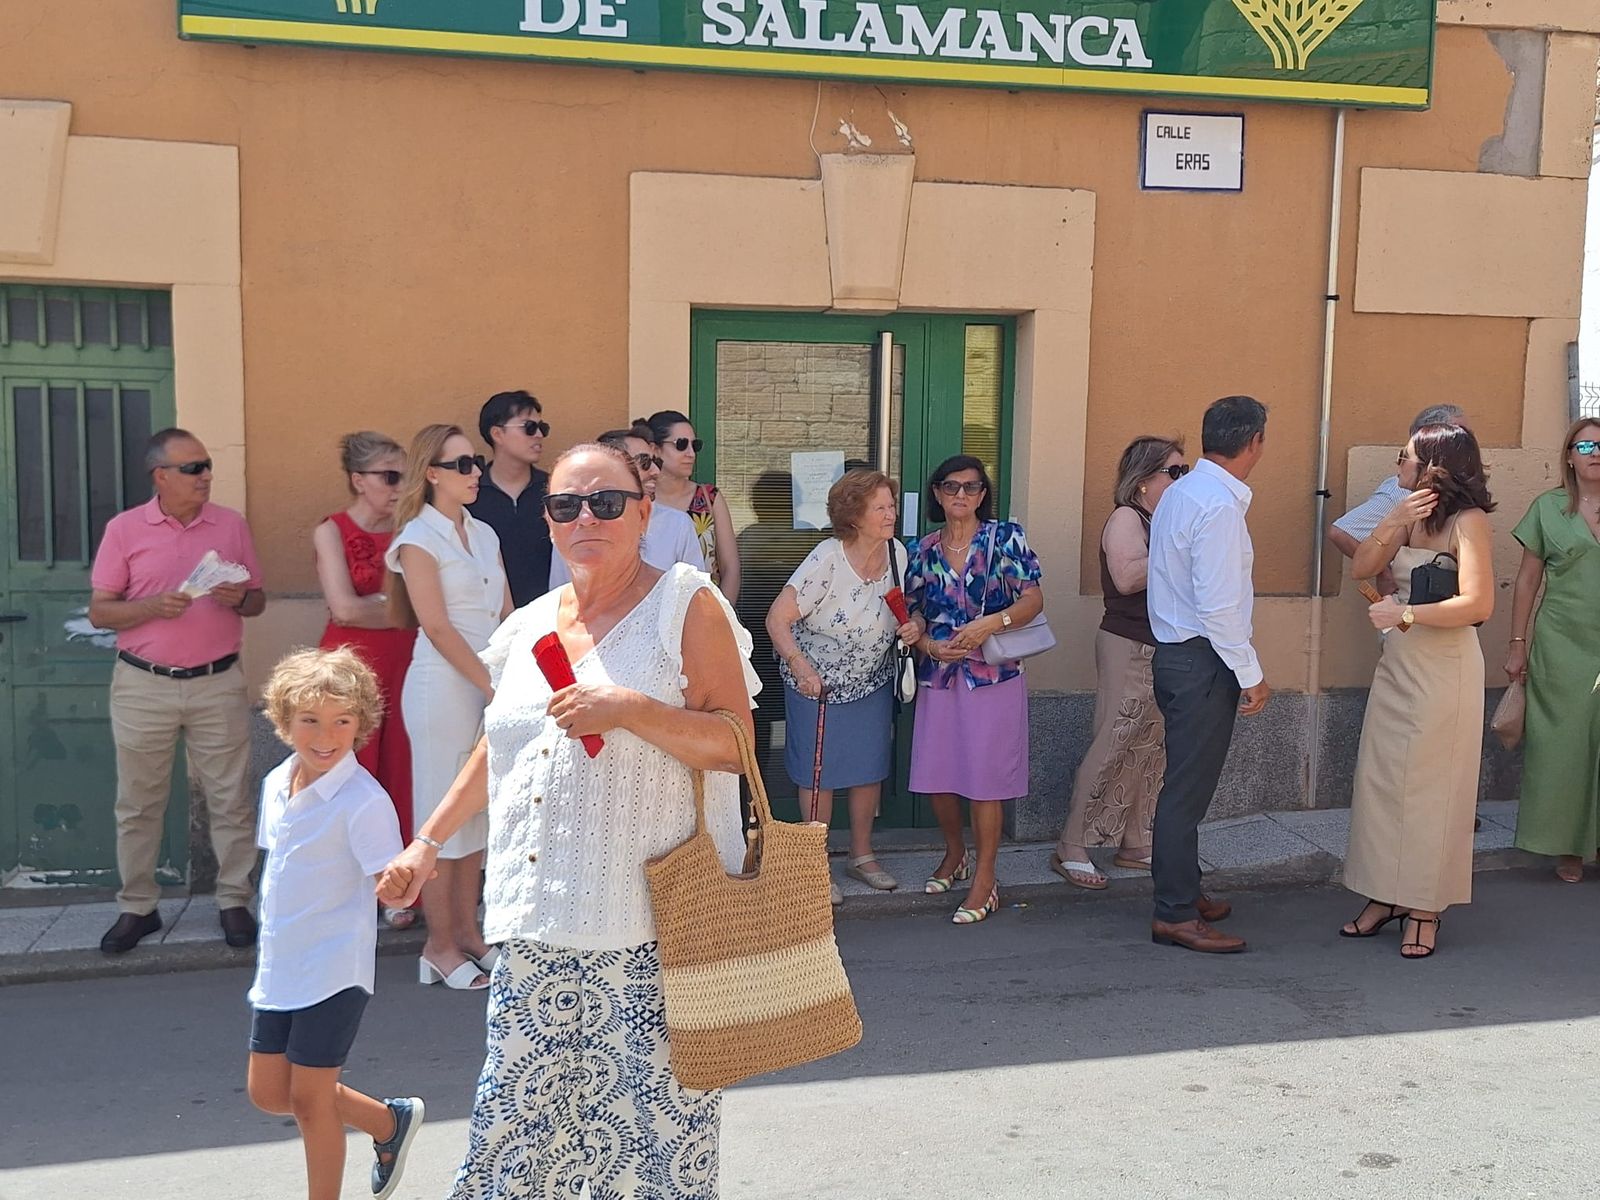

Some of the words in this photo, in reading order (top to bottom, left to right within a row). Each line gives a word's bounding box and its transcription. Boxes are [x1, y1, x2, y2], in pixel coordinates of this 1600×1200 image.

[519, 0, 628, 38] DE
[702, 0, 1153, 68] SALAMANCA
[1156, 125, 1191, 140] CALLE
[1175, 152, 1210, 171] ERAS
